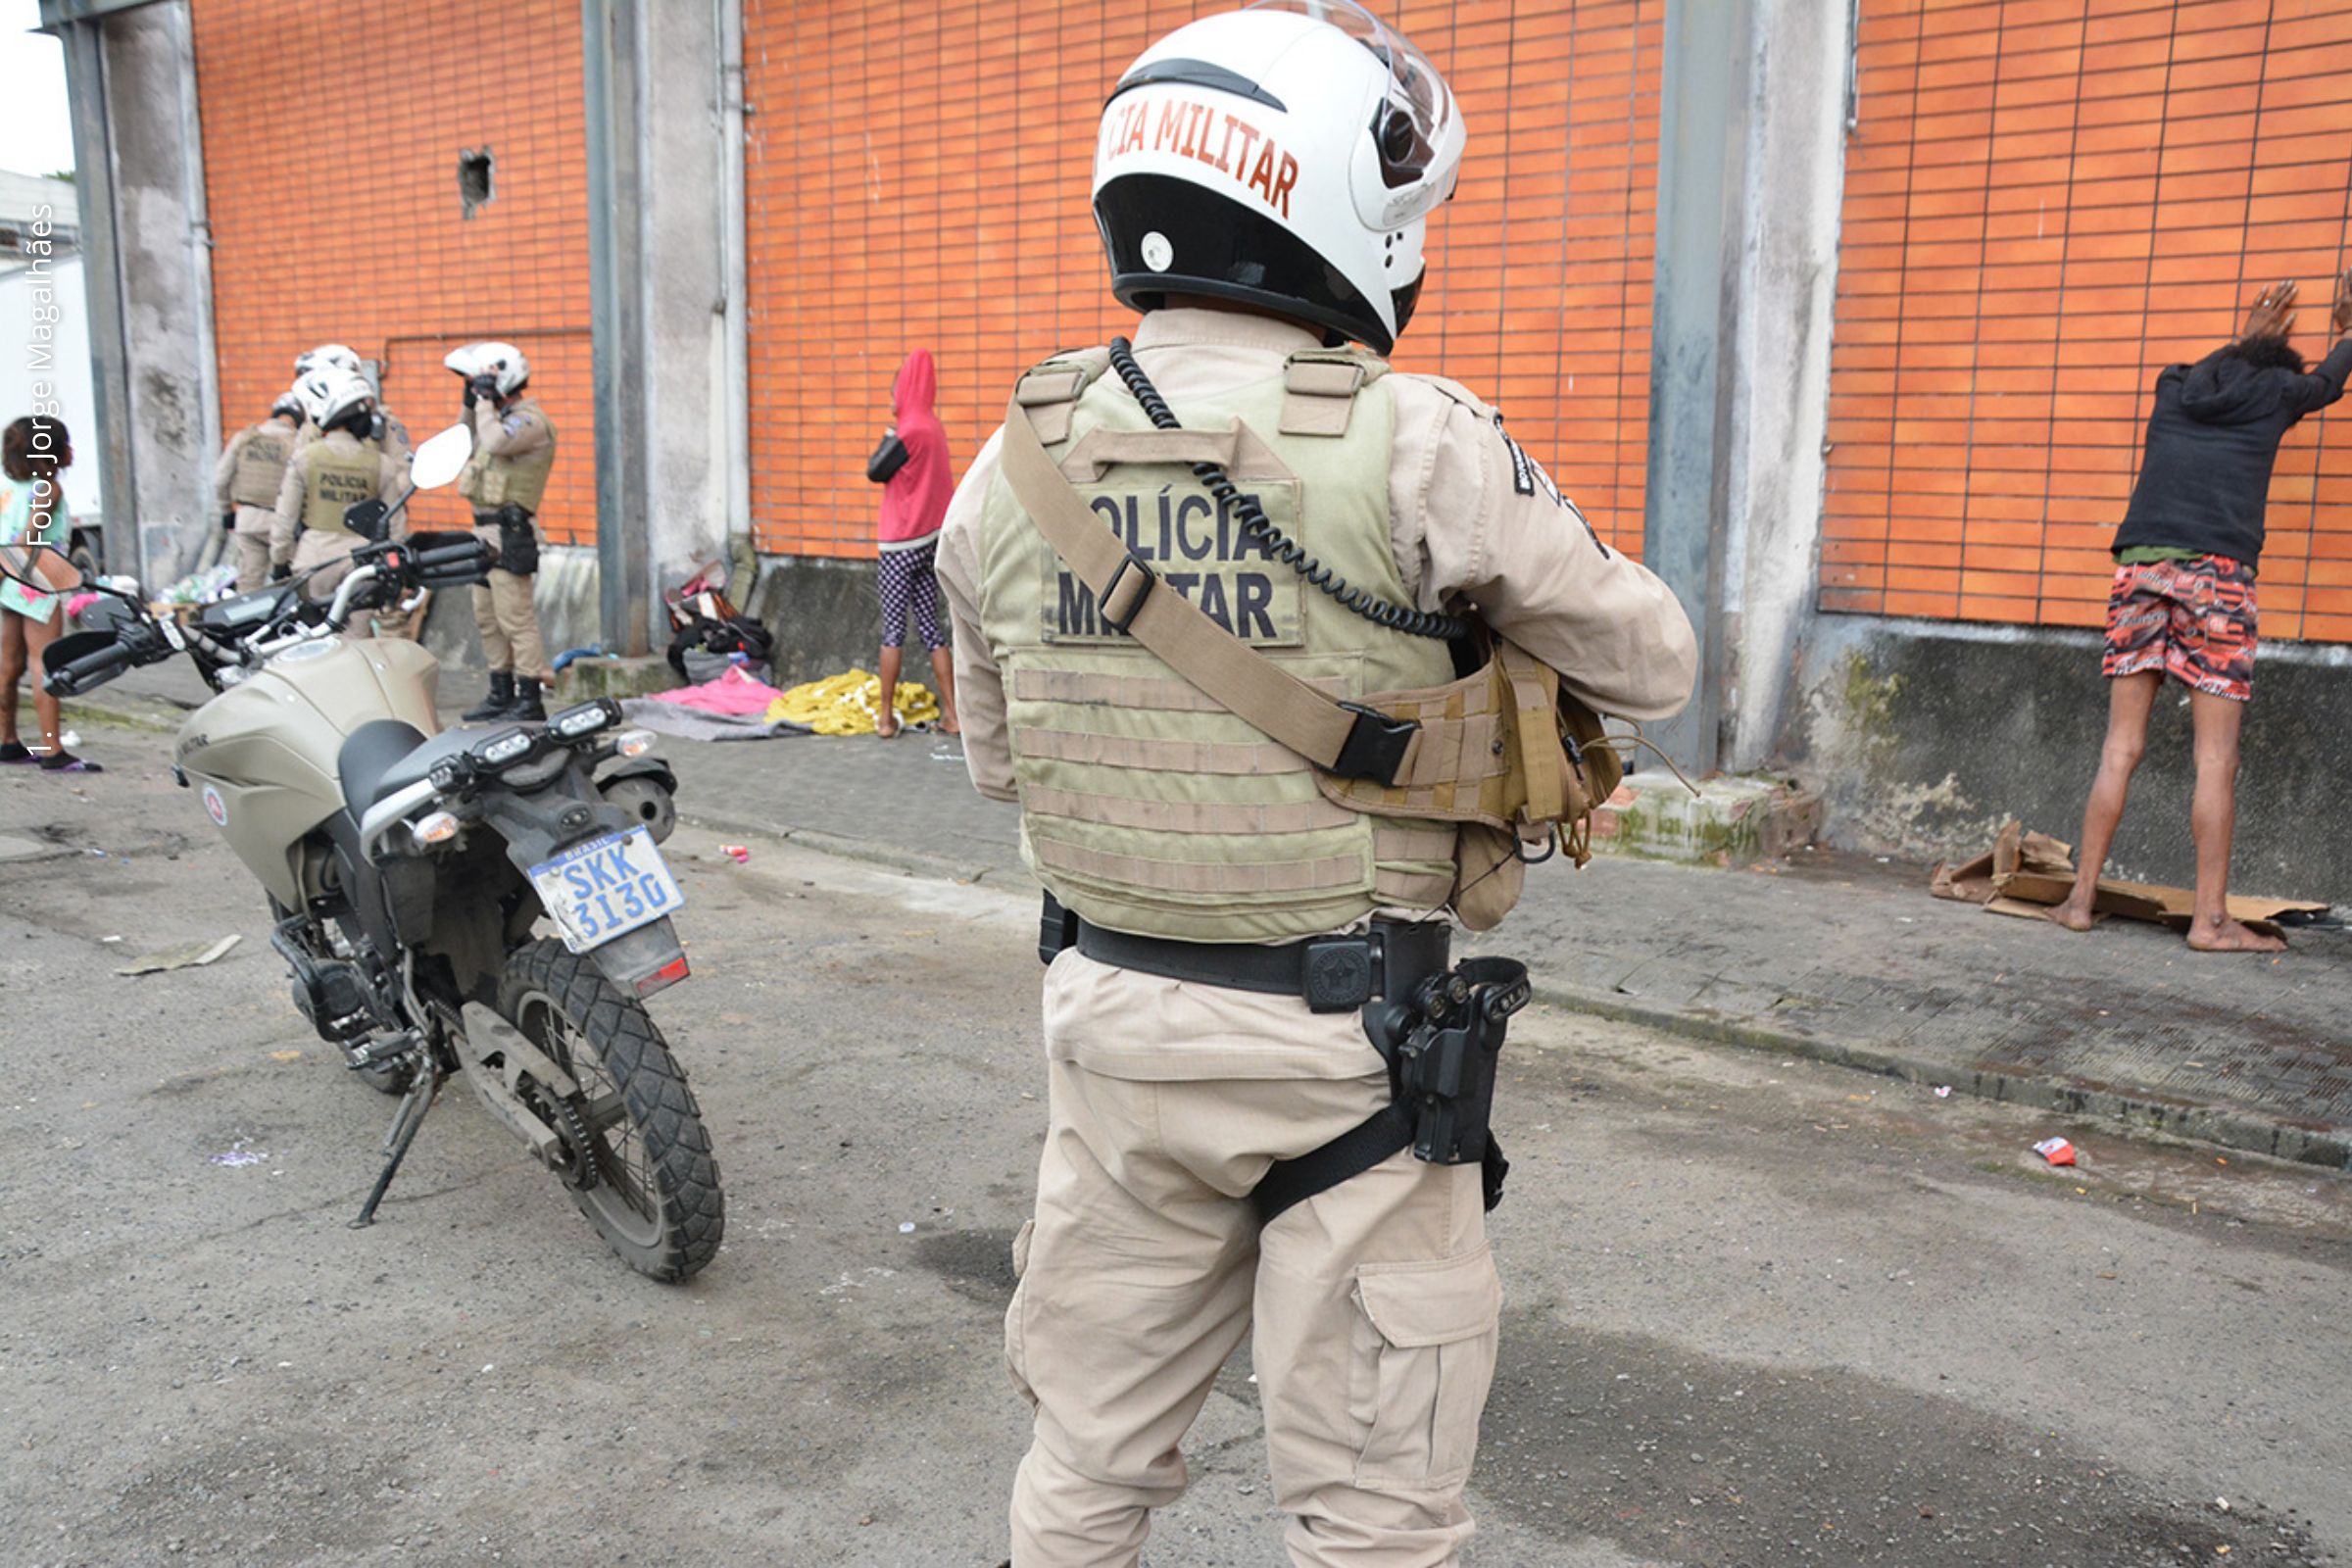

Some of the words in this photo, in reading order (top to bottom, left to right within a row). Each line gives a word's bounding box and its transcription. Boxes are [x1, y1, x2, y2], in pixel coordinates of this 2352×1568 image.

[1107, 100, 1150, 161] CIA
[1154, 99, 1298, 220] MILITAR
[1090, 484, 1274, 562] OLÍCIA
[564, 837, 610, 860] BRASIL
[564, 845, 639, 900] SKK
